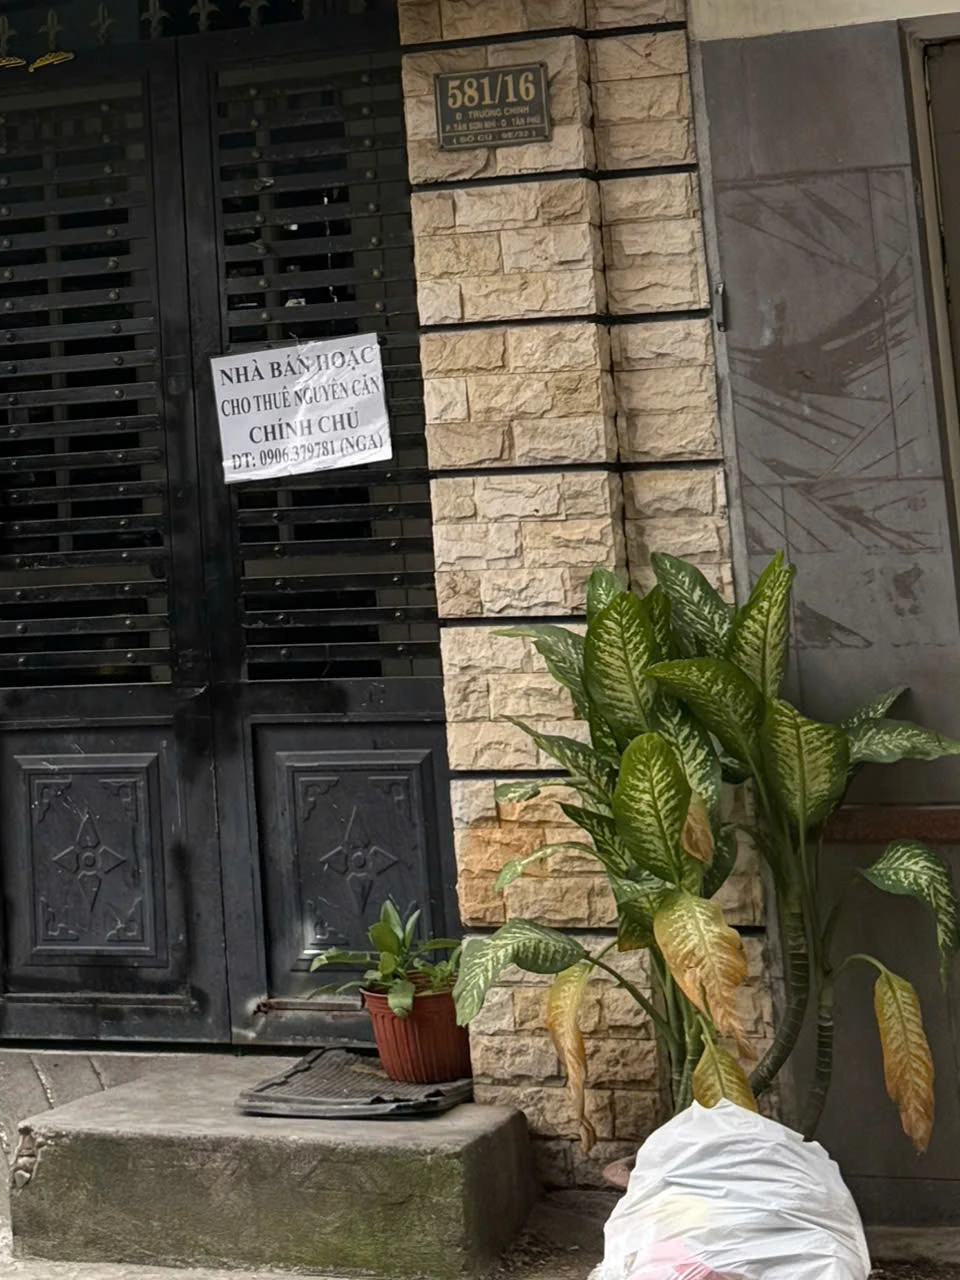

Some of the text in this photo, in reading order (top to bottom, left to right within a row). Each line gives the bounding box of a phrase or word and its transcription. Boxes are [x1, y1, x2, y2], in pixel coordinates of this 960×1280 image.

[447, 72, 536, 109] 581/16
[219, 346, 377, 386] NHÀ BÁN HOẶC
[221, 397, 251, 417] CHO
[252, 386, 291, 412] THUÊ
[294, 381, 349, 408] NGUYÊN
[249, 406, 360, 444] CHÍNH CHỦ
[259, 440, 336, 466] 0906.379781
[339, 432, 384, 455] (NGA)
